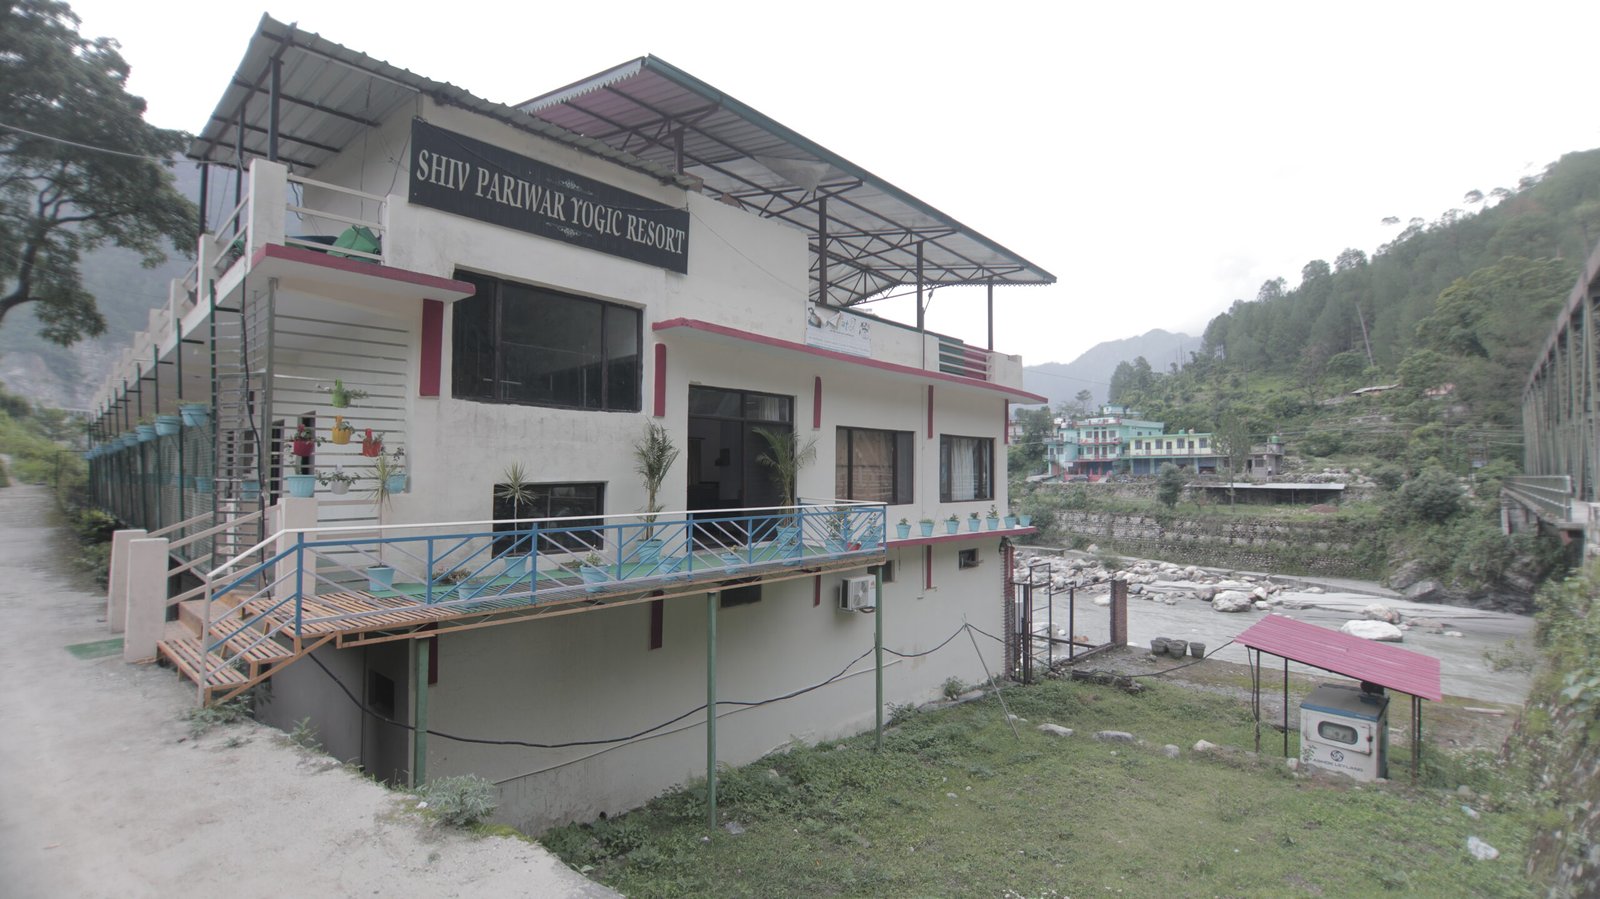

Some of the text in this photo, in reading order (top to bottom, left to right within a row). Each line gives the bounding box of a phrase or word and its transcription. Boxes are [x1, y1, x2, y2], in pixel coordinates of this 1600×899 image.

[416, 149, 685, 254] SHIV PARIWAR YOGIC RESORT
